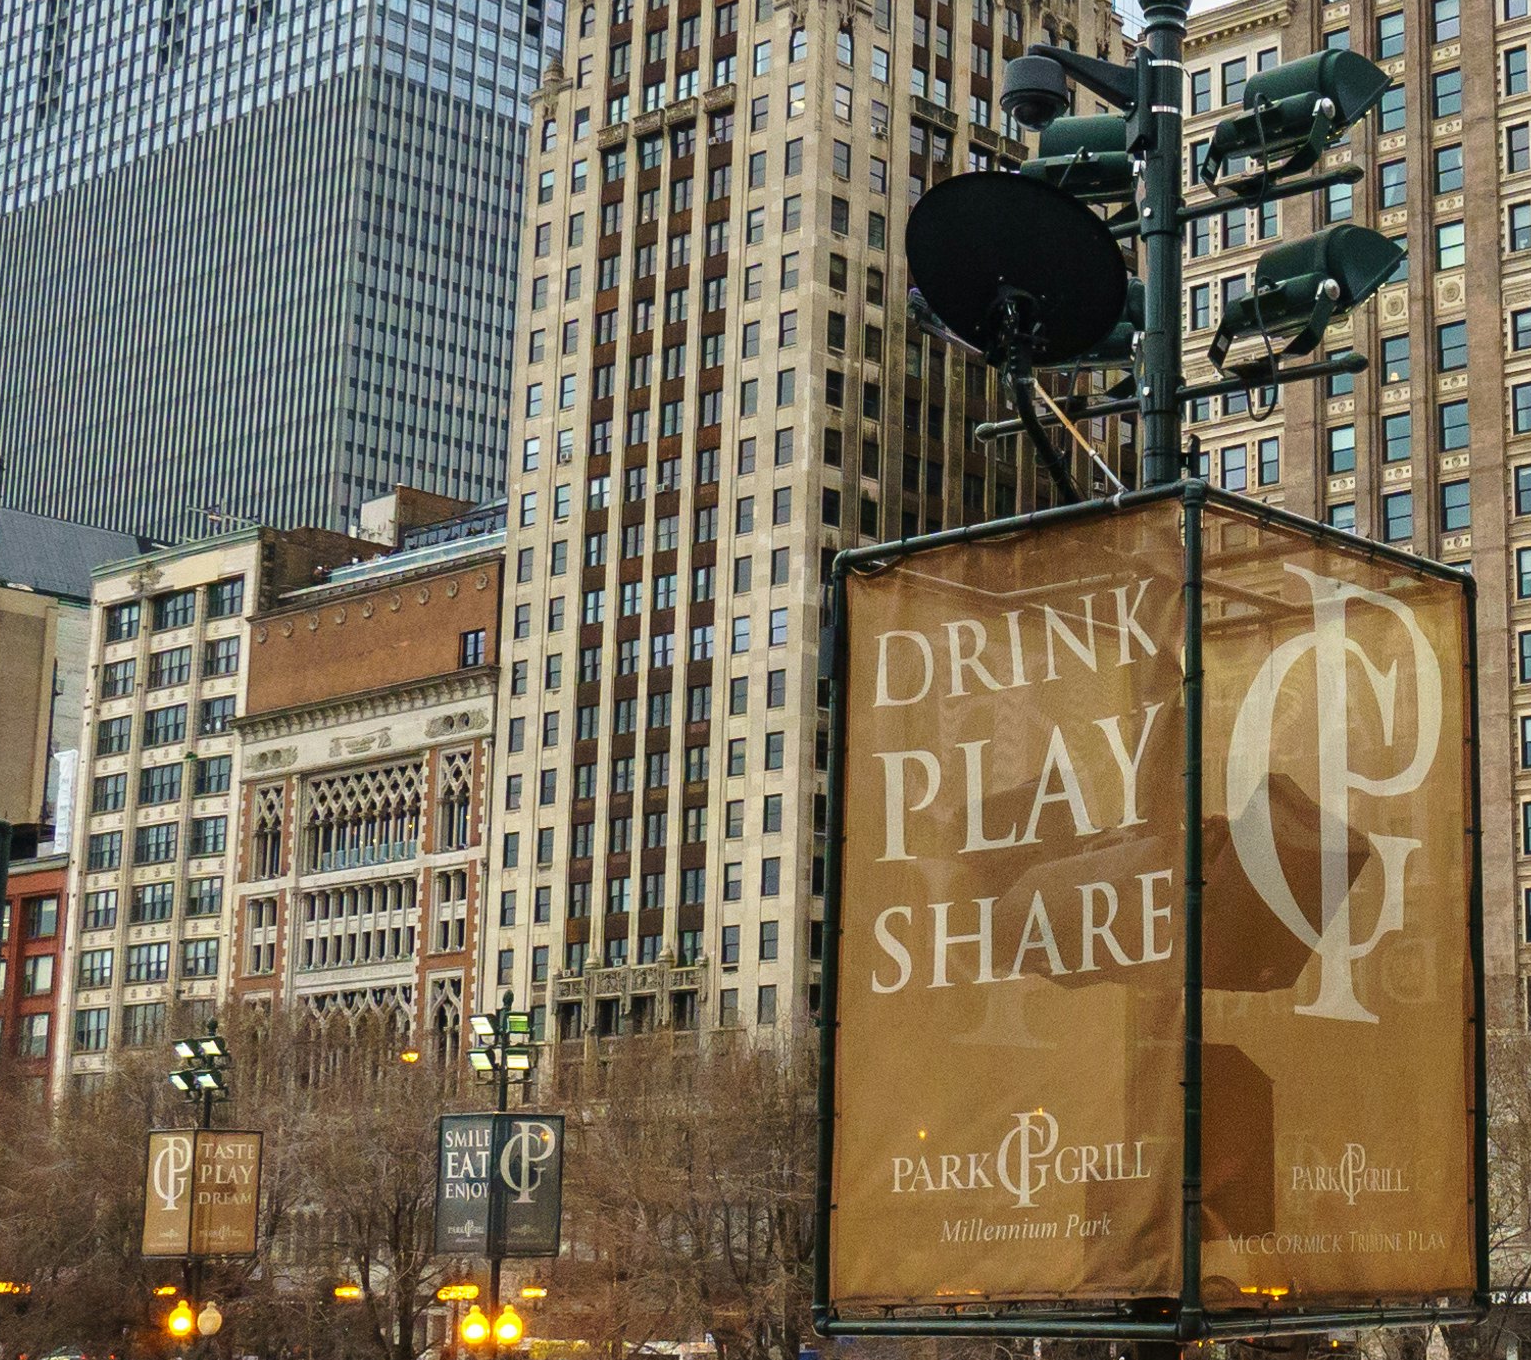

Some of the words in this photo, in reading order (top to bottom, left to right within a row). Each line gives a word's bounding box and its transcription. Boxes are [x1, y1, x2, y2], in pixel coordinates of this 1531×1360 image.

[873, 577, 1159, 709] DRINK
[872, 702, 1166, 863] PLAY
[871, 868, 1174, 995] SHARE
[201, 1143, 256, 1159] TASTE
[445, 1129, 490, 1148] SMILE
[200, 1164, 254, 1185] PLAY
[446, 1150, 490, 1179] EAT
[891, 1152, 995, 1194] PARK
[1054, 1141, 1152, 1184] GRILL
[445, 1181, 490, 1202] ENJOY
[1292, 1165, 1341, 1191] PARK
[1363, 1167, 1411, 1193] GRILL
[198, 1192, 252, 1205] DREAM
[940, 1218, 1058, 1243] Millennium
[1064, 1211, 1113, 1238] Park
